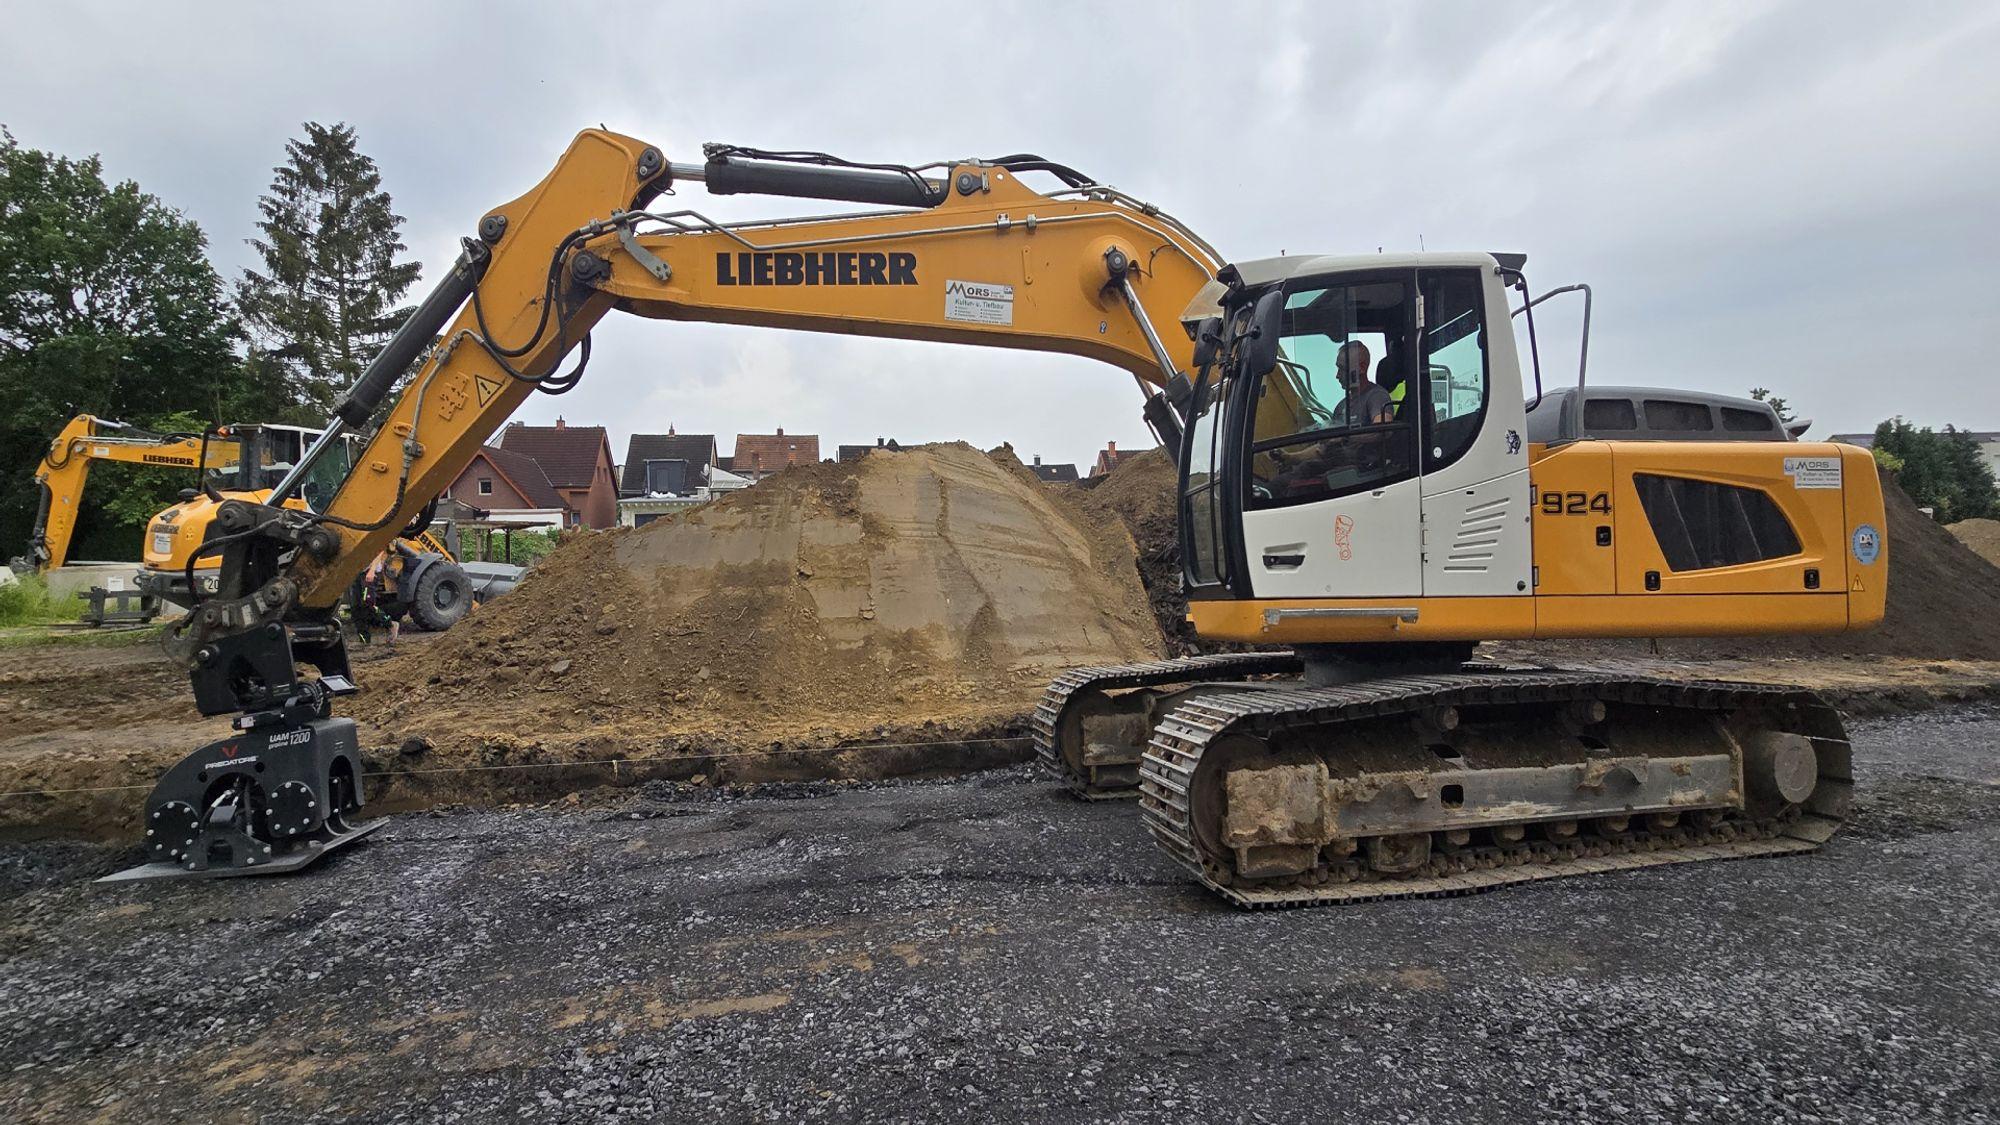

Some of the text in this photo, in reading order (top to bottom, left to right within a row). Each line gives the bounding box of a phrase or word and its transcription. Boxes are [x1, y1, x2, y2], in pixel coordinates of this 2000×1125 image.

[716, 252, 919, 286] LIEBHERR
[946, 281, 990, 298] MORS
[142, 454, 194, 466] LIEBHERR
[1796, 461, 1830, 471] MORS
[1542, 490, 1613, 514] 924
[290, 731, 311, 745] 1200
